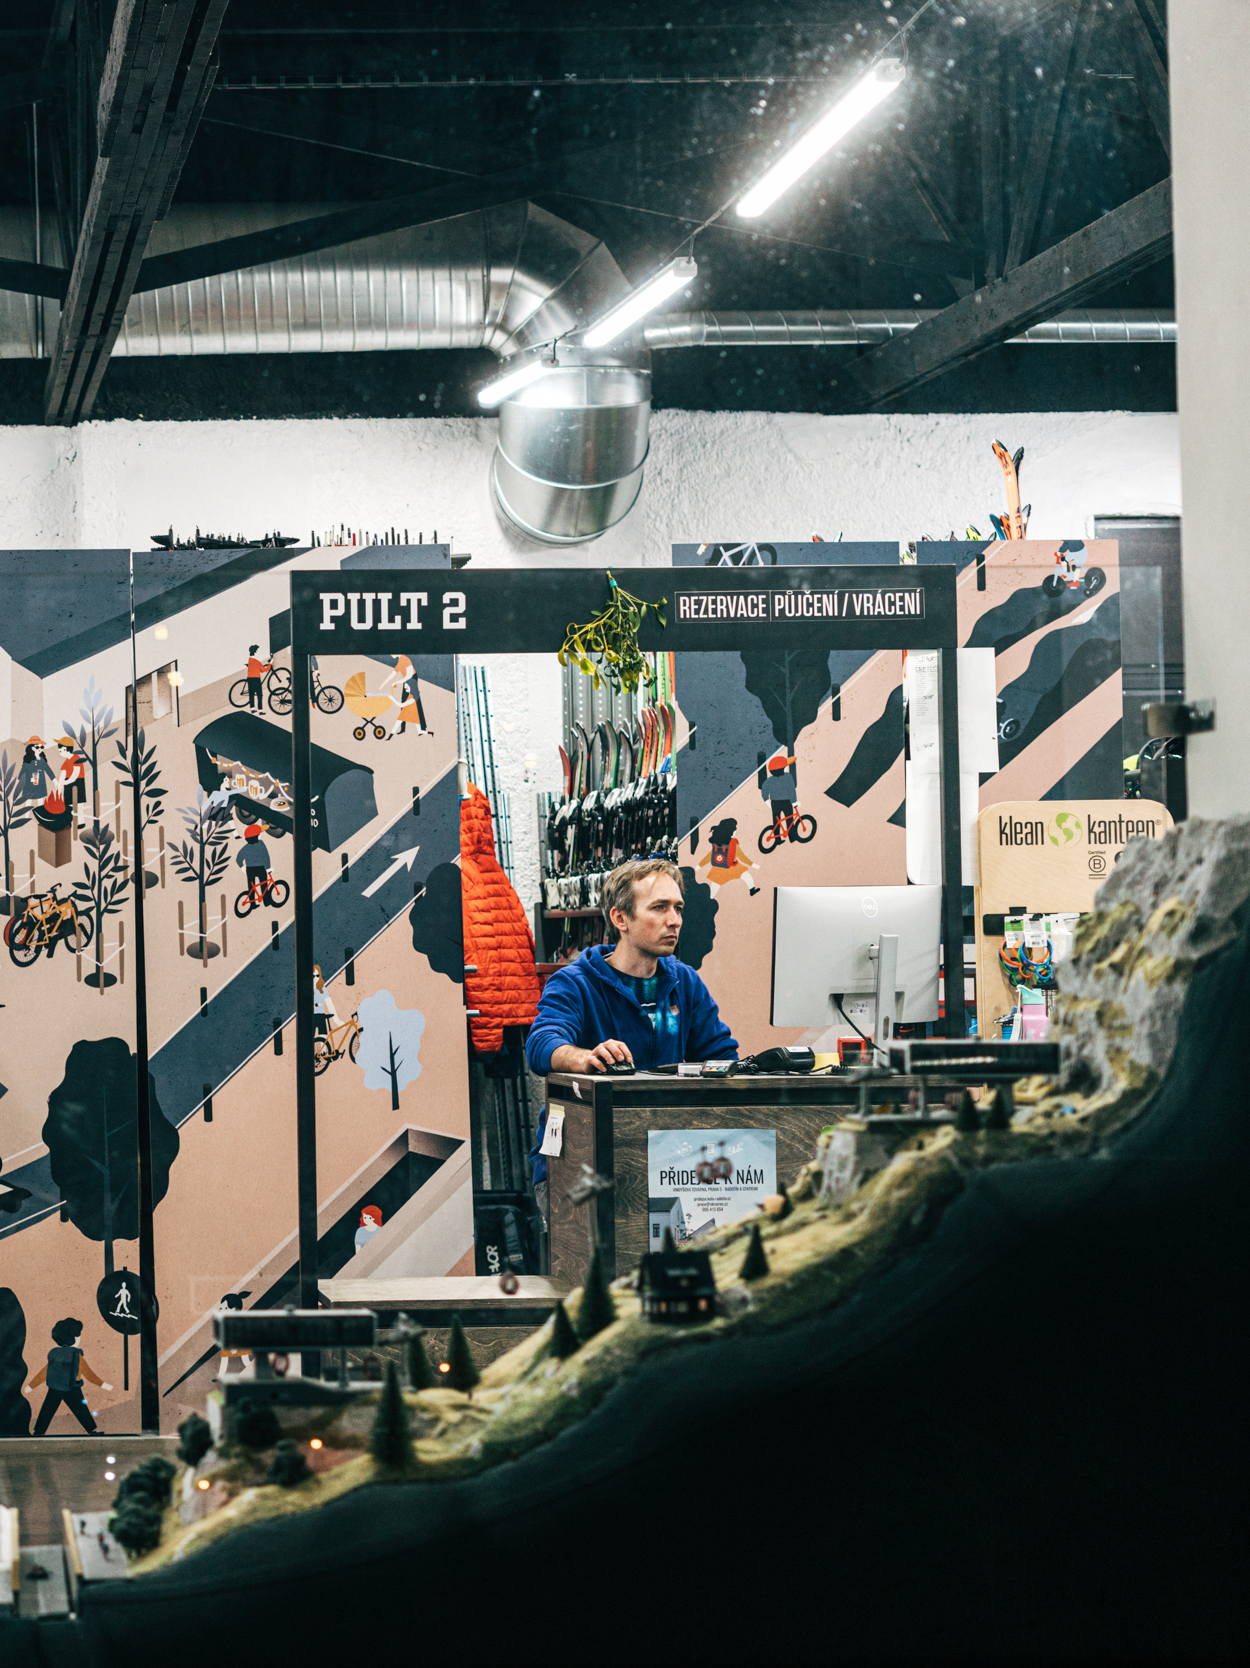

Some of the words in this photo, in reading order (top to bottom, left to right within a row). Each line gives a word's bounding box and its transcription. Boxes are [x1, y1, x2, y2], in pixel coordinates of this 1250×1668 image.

[319, 592, 428, 630] PULT
[442, 591, 466, 630] 2
[679, 594, 767, 618] REZERVACE
[774, 589, 839, 617] PŮJČENÍ
[842, 593, 849, 617] /
[852, 588, 921, 616] VRÁCENÍ
[999, 815, 1044, 846] klean
[660, 1166, 701, 1186] PŘIDE
[737, 1165, 764, 1184] NÁM
